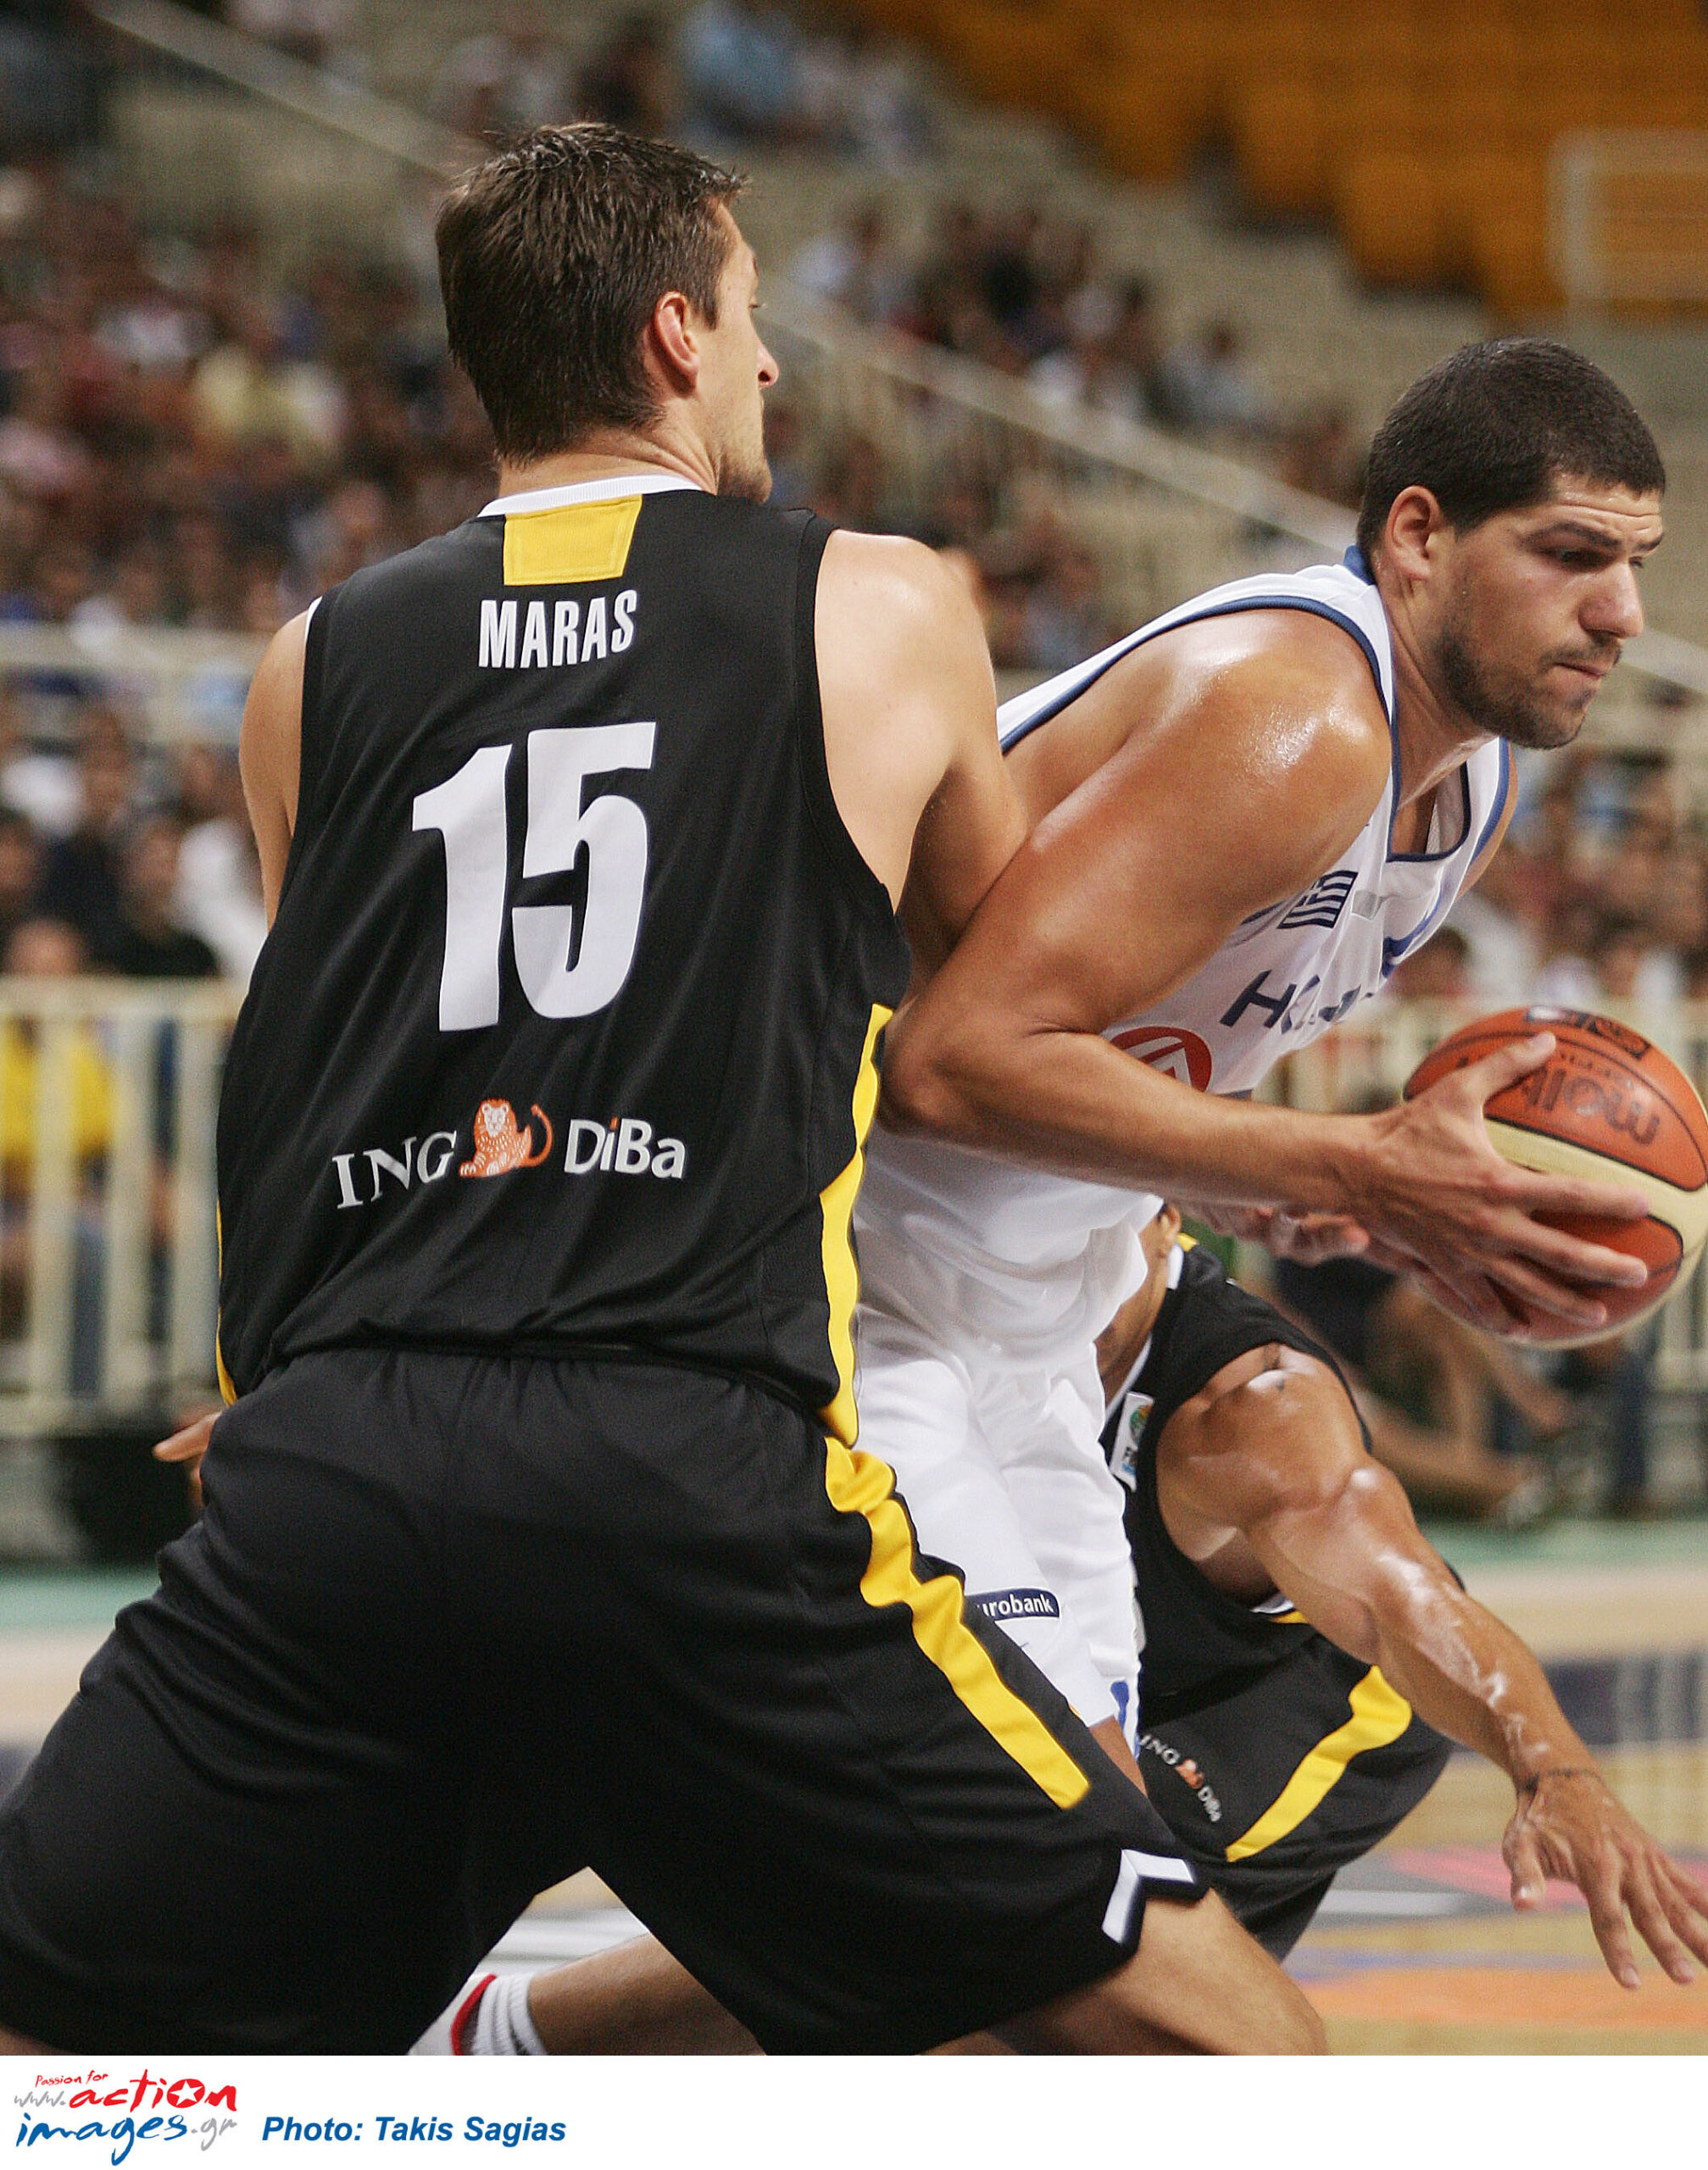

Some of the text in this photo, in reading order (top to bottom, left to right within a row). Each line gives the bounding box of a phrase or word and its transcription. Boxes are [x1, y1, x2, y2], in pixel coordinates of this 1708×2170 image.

[478, 589, 637, 669] MARAS
[412, 721, 656, 1032] 15
[331, 1116, 686, 1209] ING DiBa
[976, 1593, 1054, 1616] urobank
